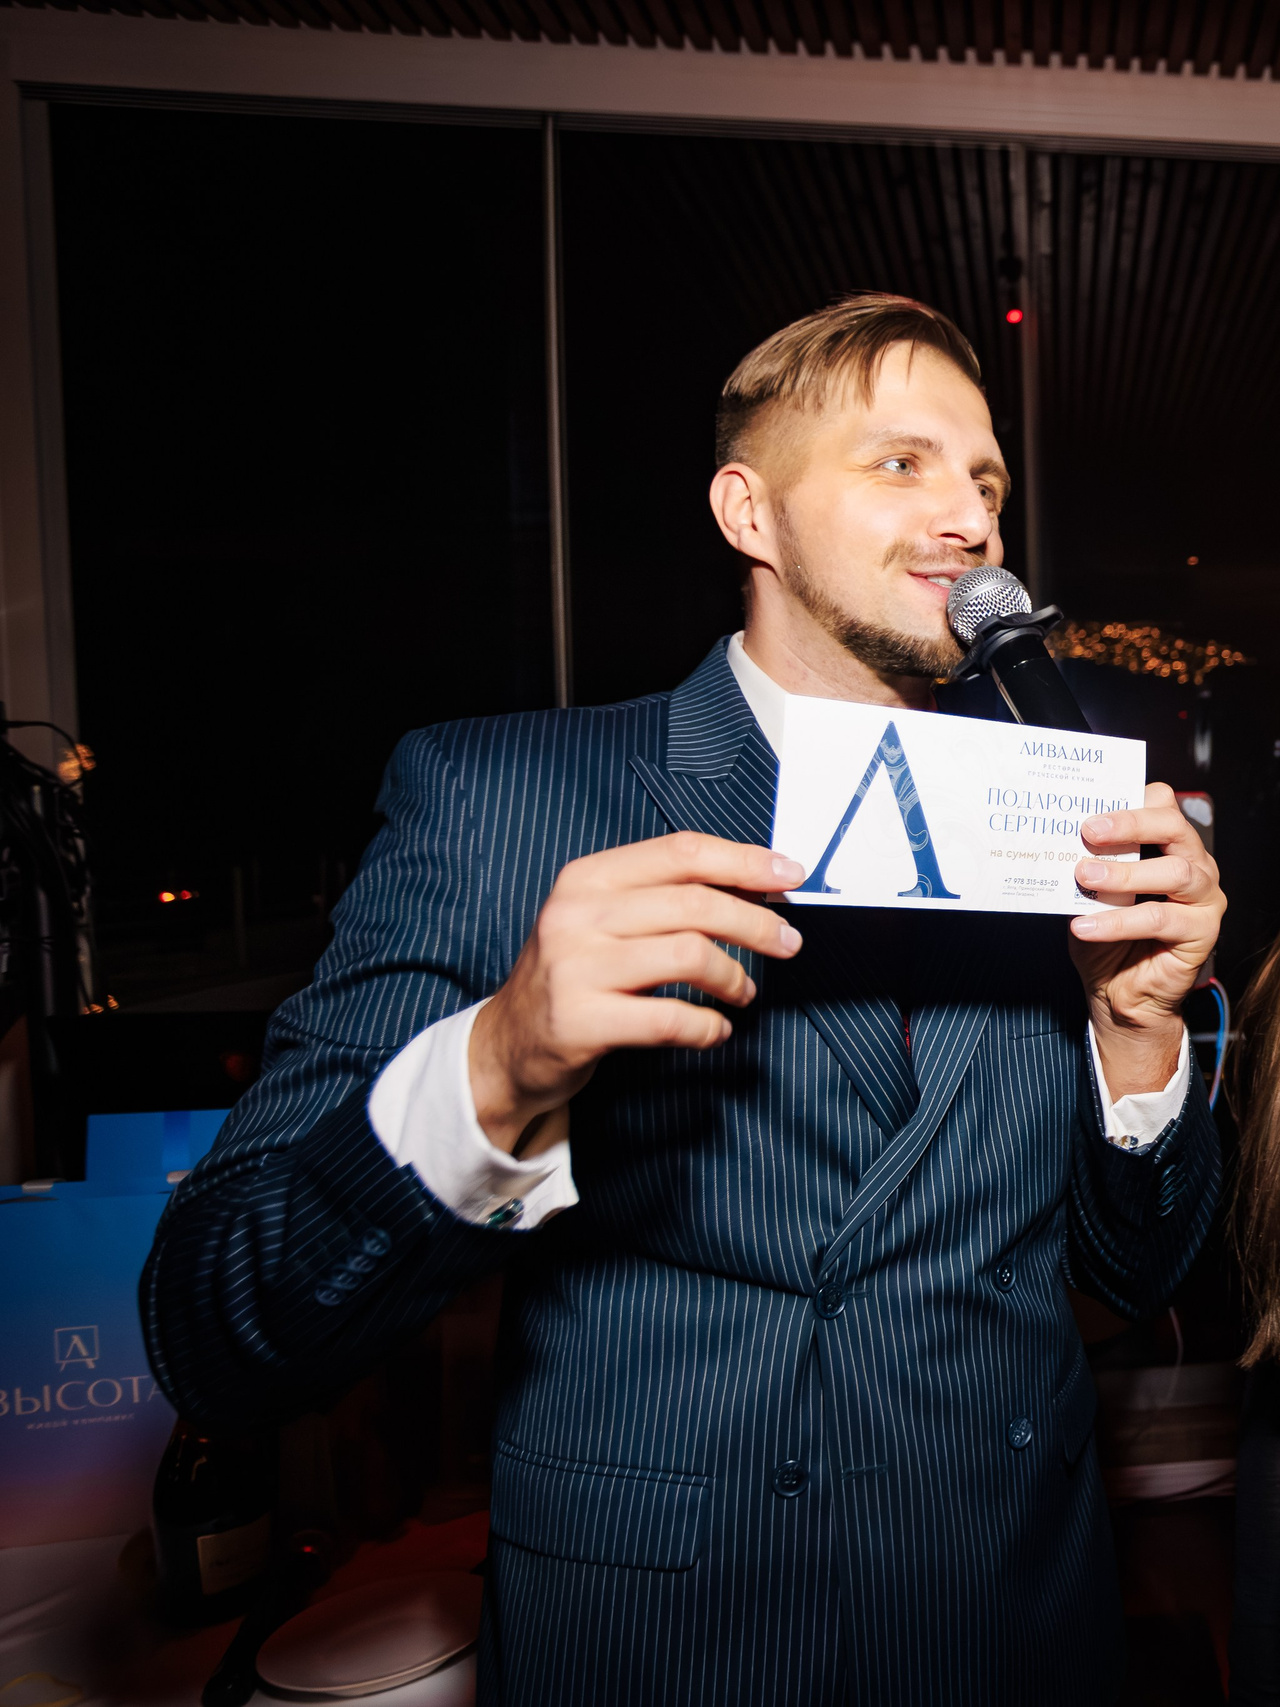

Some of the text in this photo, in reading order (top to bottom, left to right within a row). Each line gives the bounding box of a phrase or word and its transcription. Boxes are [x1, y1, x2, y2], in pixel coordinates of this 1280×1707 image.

[1019, 741, 1103, 764] ЛИВАДИЯ
[1043, 763, 1081, 773] РЕСТОРАН
[987, 787, 1129, 815] ПОДАРОЧНЫЙ
[990, 849, 1003, 858] на
[1006, 850, 1041, 862] сумму
[1043, 851, 1055, 862] 10
[1058, 852, 1079, 863] 000
[1013, 877, 1025, 885] 978
[1026, 878, 1059, 887] 315-83-20
